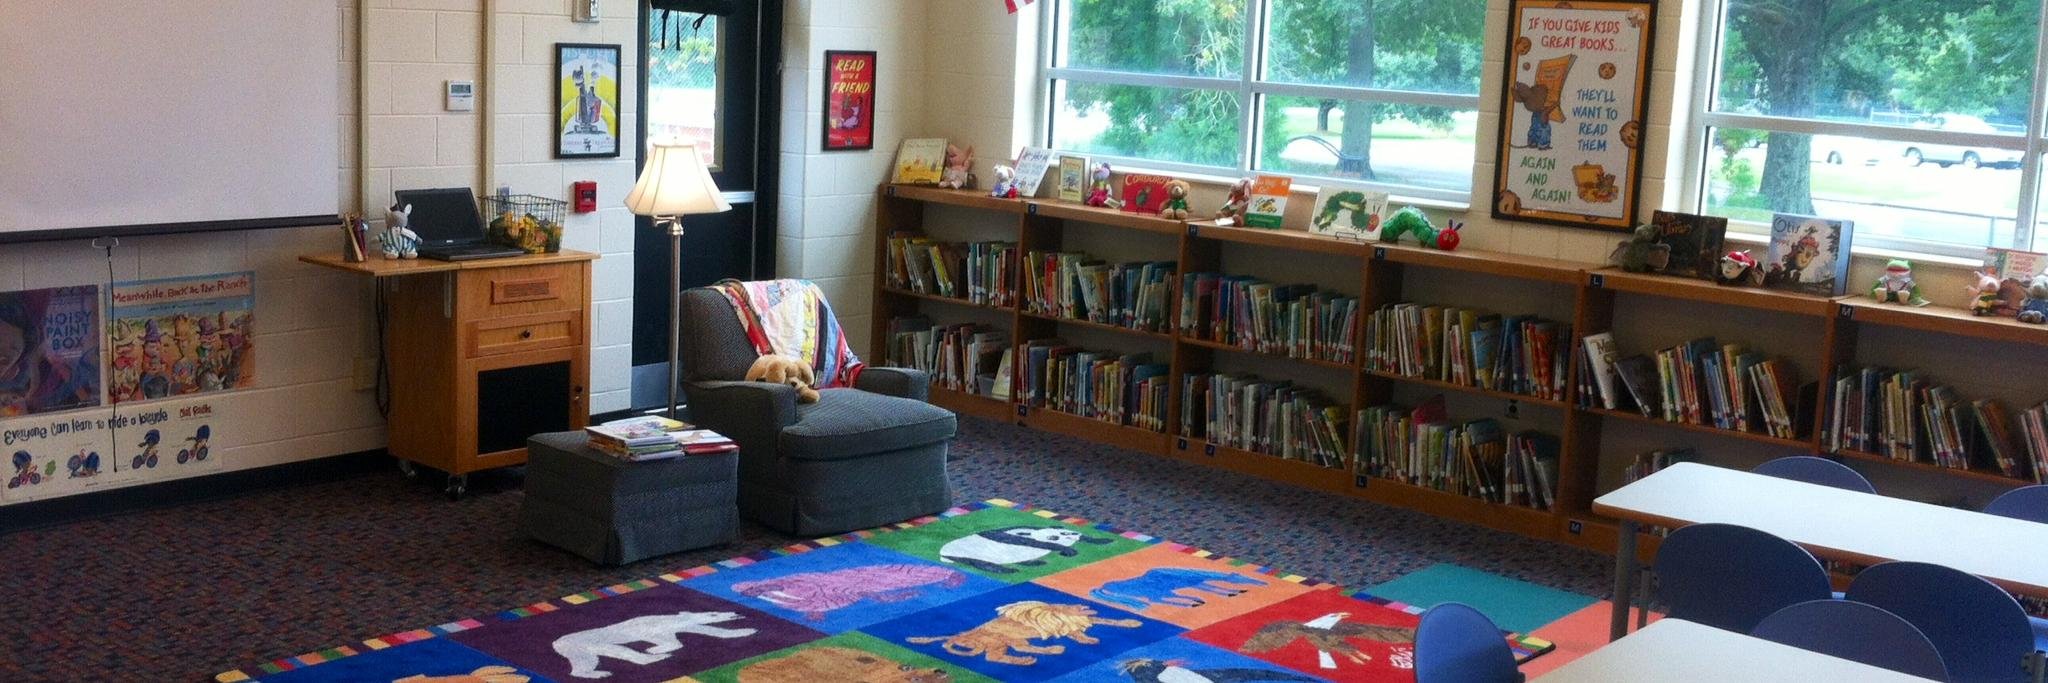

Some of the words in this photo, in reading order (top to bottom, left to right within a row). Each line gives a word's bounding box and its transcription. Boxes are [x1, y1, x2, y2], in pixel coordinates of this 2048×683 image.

[1528, 17, 1540, 30] IF
[1543, 19, 1562, 31] YOU
[1565, 20, 1591, 33] GIVE
[1594, 21, 1620, 34] KIDS
[1541, 36, 1576, 49] GREAT
[1580, 38, 1627, 52] BOOKS...
[835, 59, 865, 72] READ
[832, 82, 870, 93] FRIEND
[1577, 88, 1616, 102] THEY'LL
[1572, 106, 1602, 119] WANT
[1605, 107, 1618, 120] TO
[1578, 123, 1608, 136] READ
[1578, 139, 1607, 152] THEM
[1520, 156, 1556, 170] AGAIN
[1525, 173, 1548, 185] AND
[1531, 188, 1571, 203] AGAIN!
[1774, 216, 1800, 233] Otis
[44, 310, 92, 325] NOISY
[47, 323, 89, 337] PAINT
[52, 336, 84, 350] BOX
[4, 427, 47, 445] Everyone
[96, 419, 105, 430] to
[138, 408, 168, 426] bicycle
